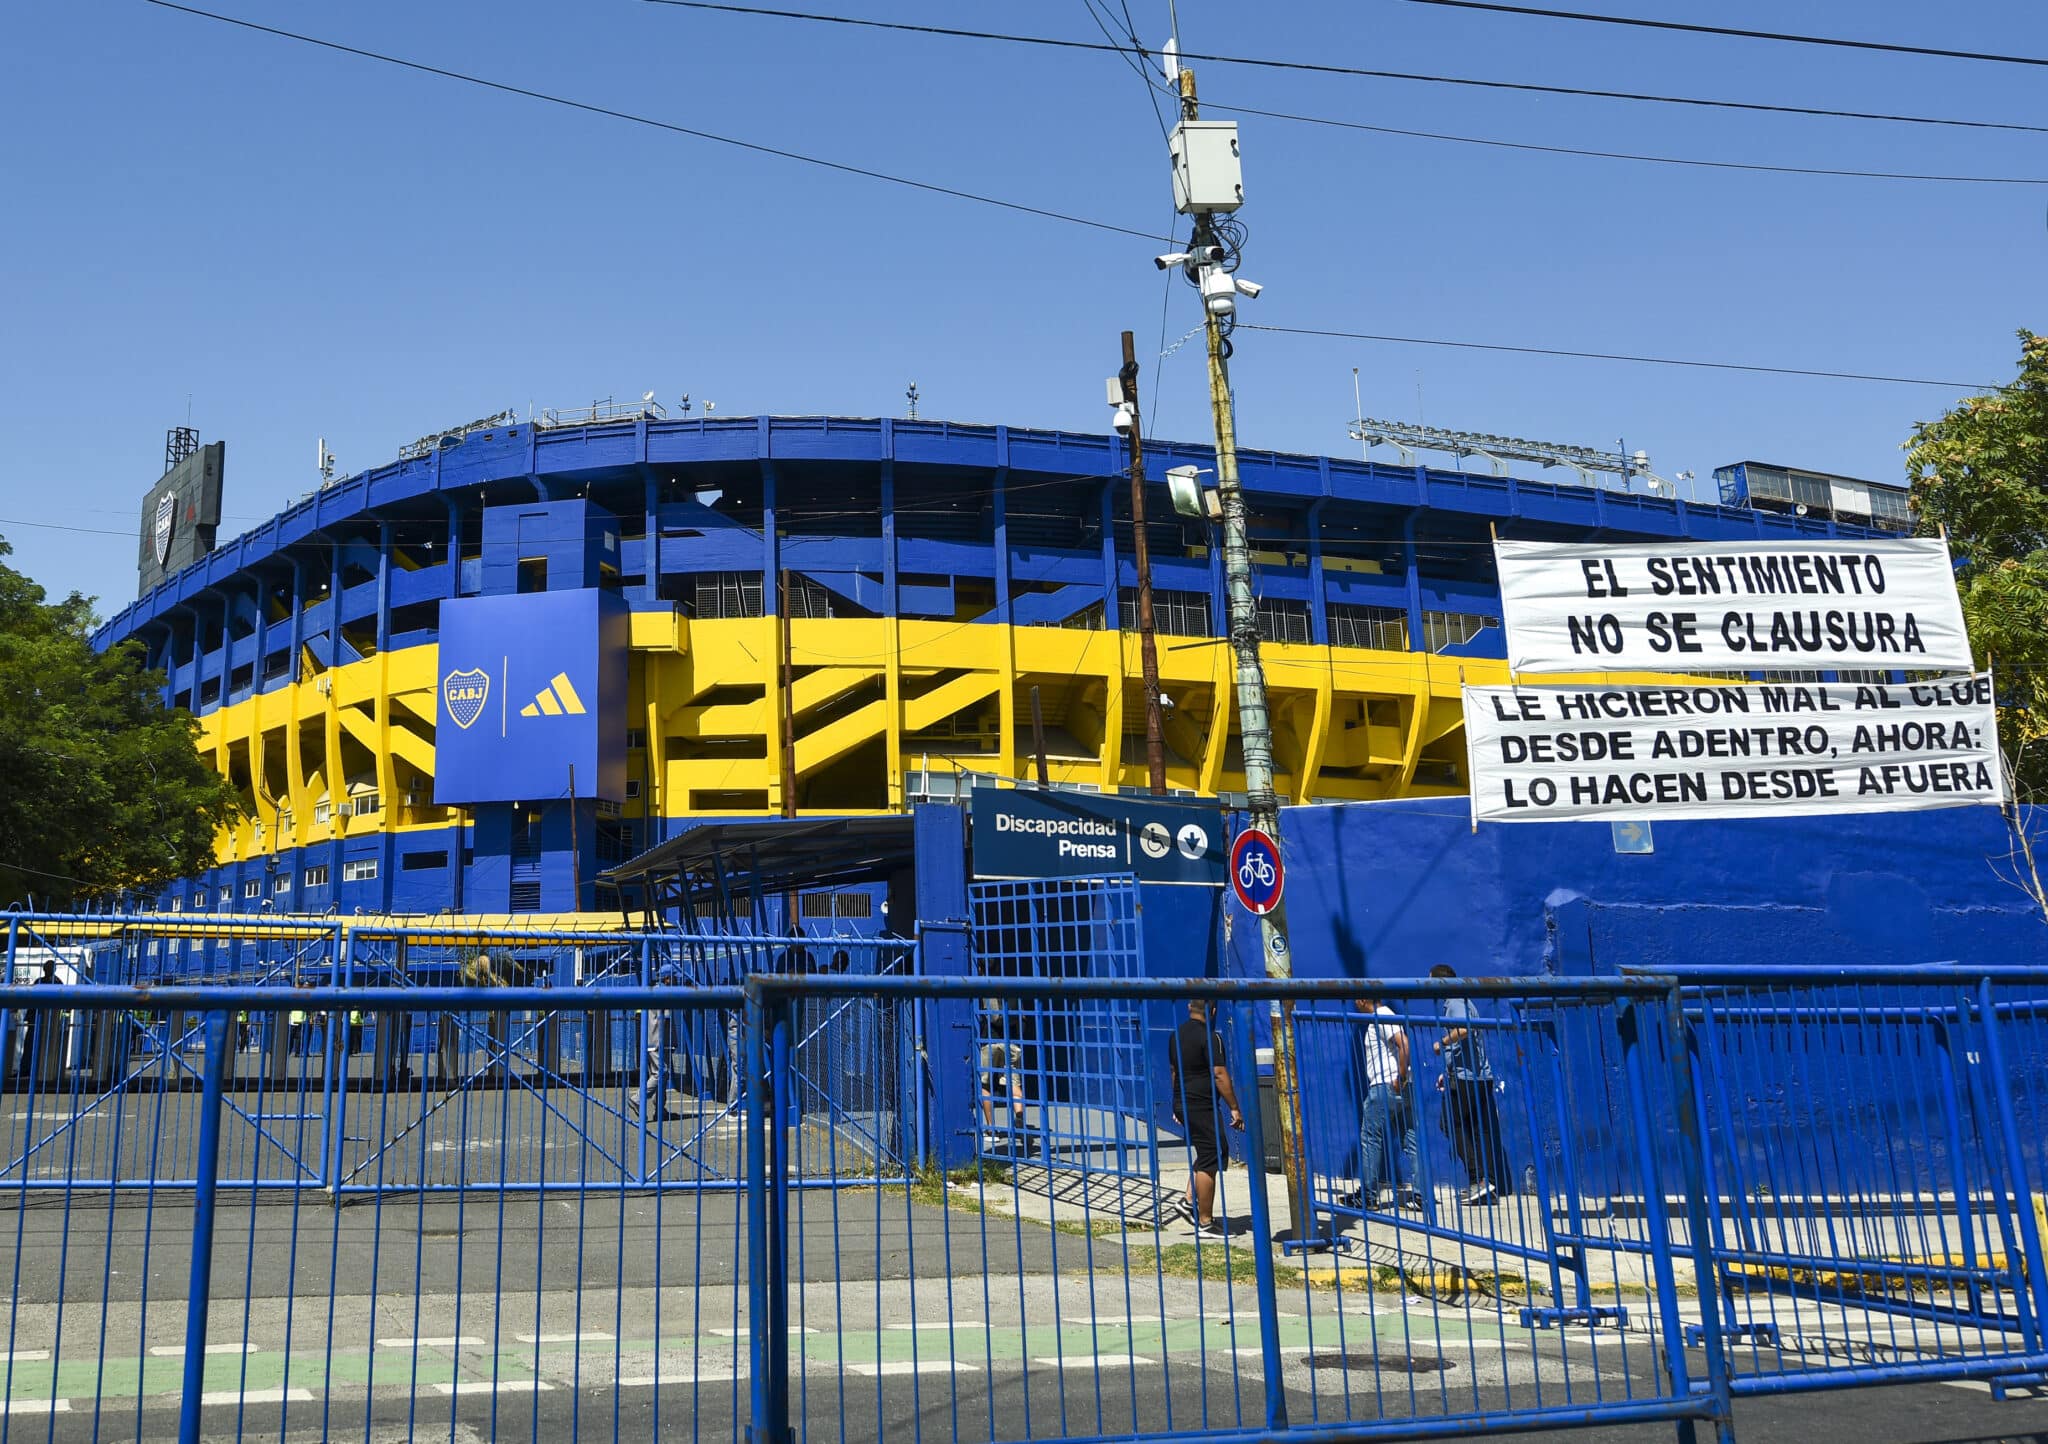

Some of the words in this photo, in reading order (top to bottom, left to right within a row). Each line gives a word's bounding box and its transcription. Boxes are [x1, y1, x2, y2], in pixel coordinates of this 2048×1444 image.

[1581, 559, 1628, 598] EL
[1647, 555, 1886, 596] SENTIMIENTO
[1568, 613, 1623, 655] NO
[1646, 611, 1703, 653] SE
[1721, 609, 1926, 654] CLAUSURA
[449, 687, 483, 701] CABJ
[1491, 694, 1546, 721] LE
[1556, 686, 1749, 720] HICIERON
[1759, 685, 1840, 713] MAL
[1855, 685, 1901, 709] AL
[1909, 676, 1991, 707] CLUB
[1501, 731, 1635, 764] DESDE
[1652, 725, 1838, 760] ADENTRO,
[1851, 720, 1981, 753] AHORA:
[1504, 777, 1557, 808] LO
[1570, 771, 1707, 805] HACEN
[1721, 768, 1839, 801] DESDE
[1857, 761, 1993, 795] AFUERA
[996, 813, 1117, 837] Discapacidad
[1058, 839, 1117, 858] Prensa
